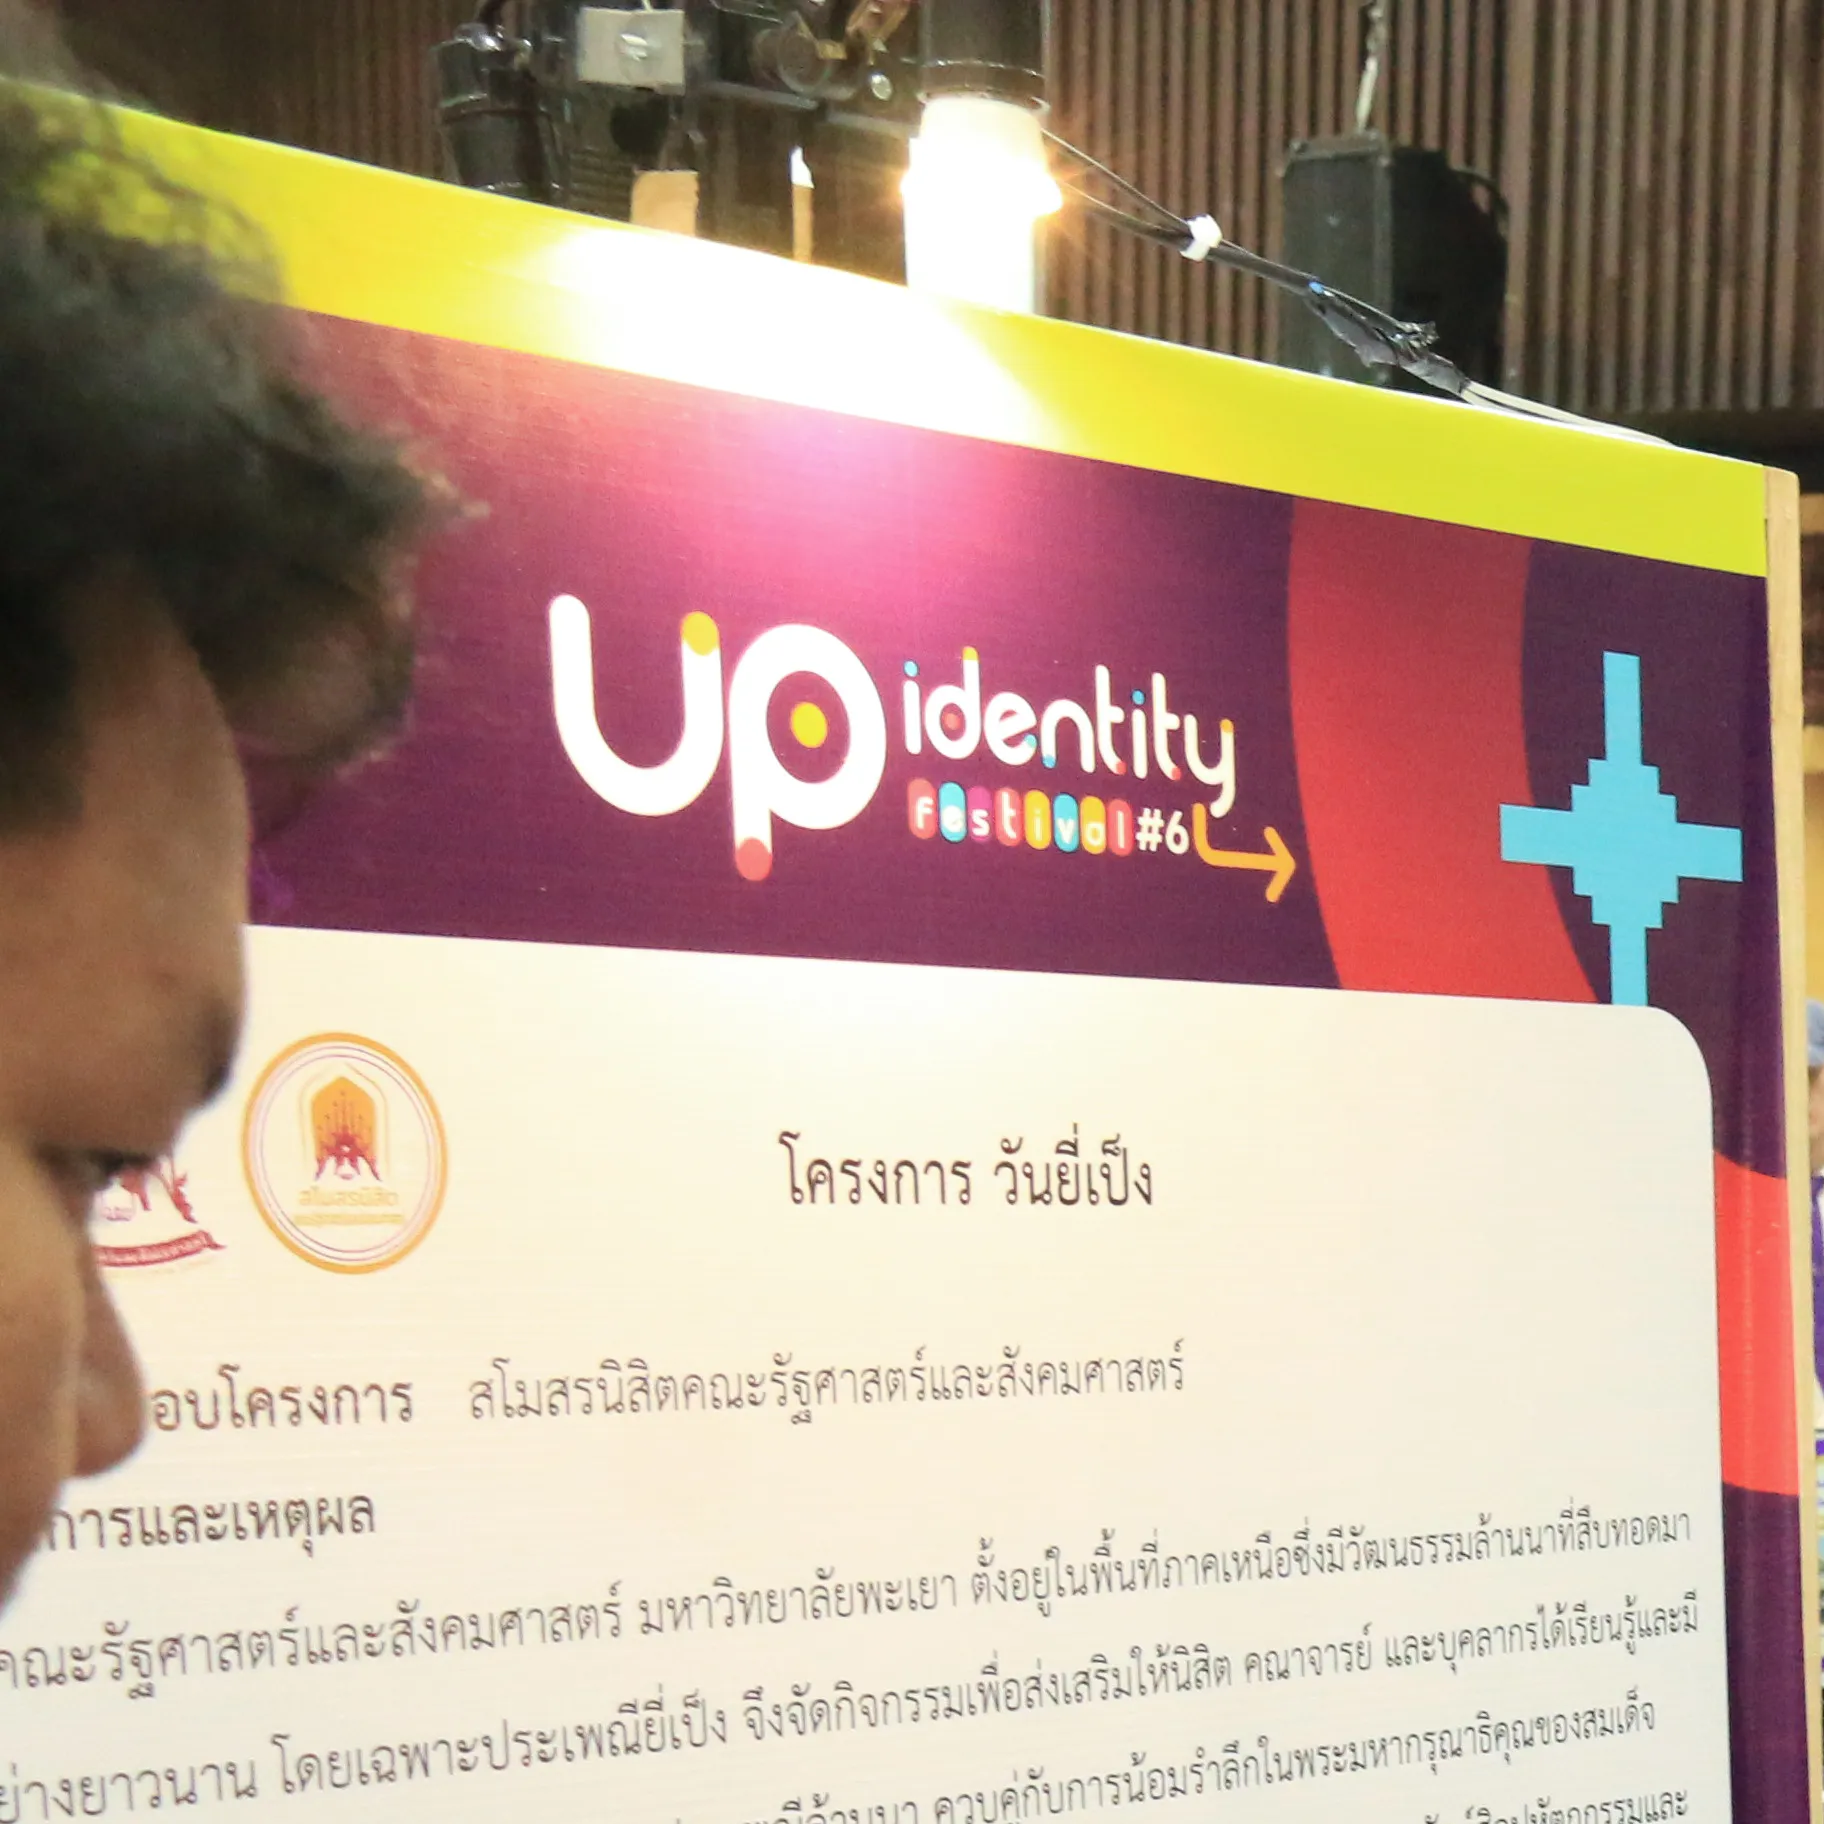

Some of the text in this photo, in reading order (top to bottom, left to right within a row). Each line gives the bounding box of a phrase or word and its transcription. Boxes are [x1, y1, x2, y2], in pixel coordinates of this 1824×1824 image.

[903, 646, 1236, 817] identity
[1135, 807, 1190, 856] #6
[778, 1122, 1154, 1206] โครงการ วันยี่เป็ง
[469, 1338, 1186, 1426] สโมสรนิสิตคณะรัฐศาสตร์และสังคมศาสตร์
[639, 1565, 957, 1636] มหาวิทยาลัยพะเยา
[270, 1683, 728, 1795] โดยเฉพาะประเพณียี่เป็ง
[743, 1640, 1233, 1739] จึงจัดกิจกรรมเพื่อส่งเสริมให้นิสิต
[1244, 1623, 1373, 1686] คณาจารย์
[1385, 1590, 1699, 1674] และบุคลากรได้เรียนรู้และมี
